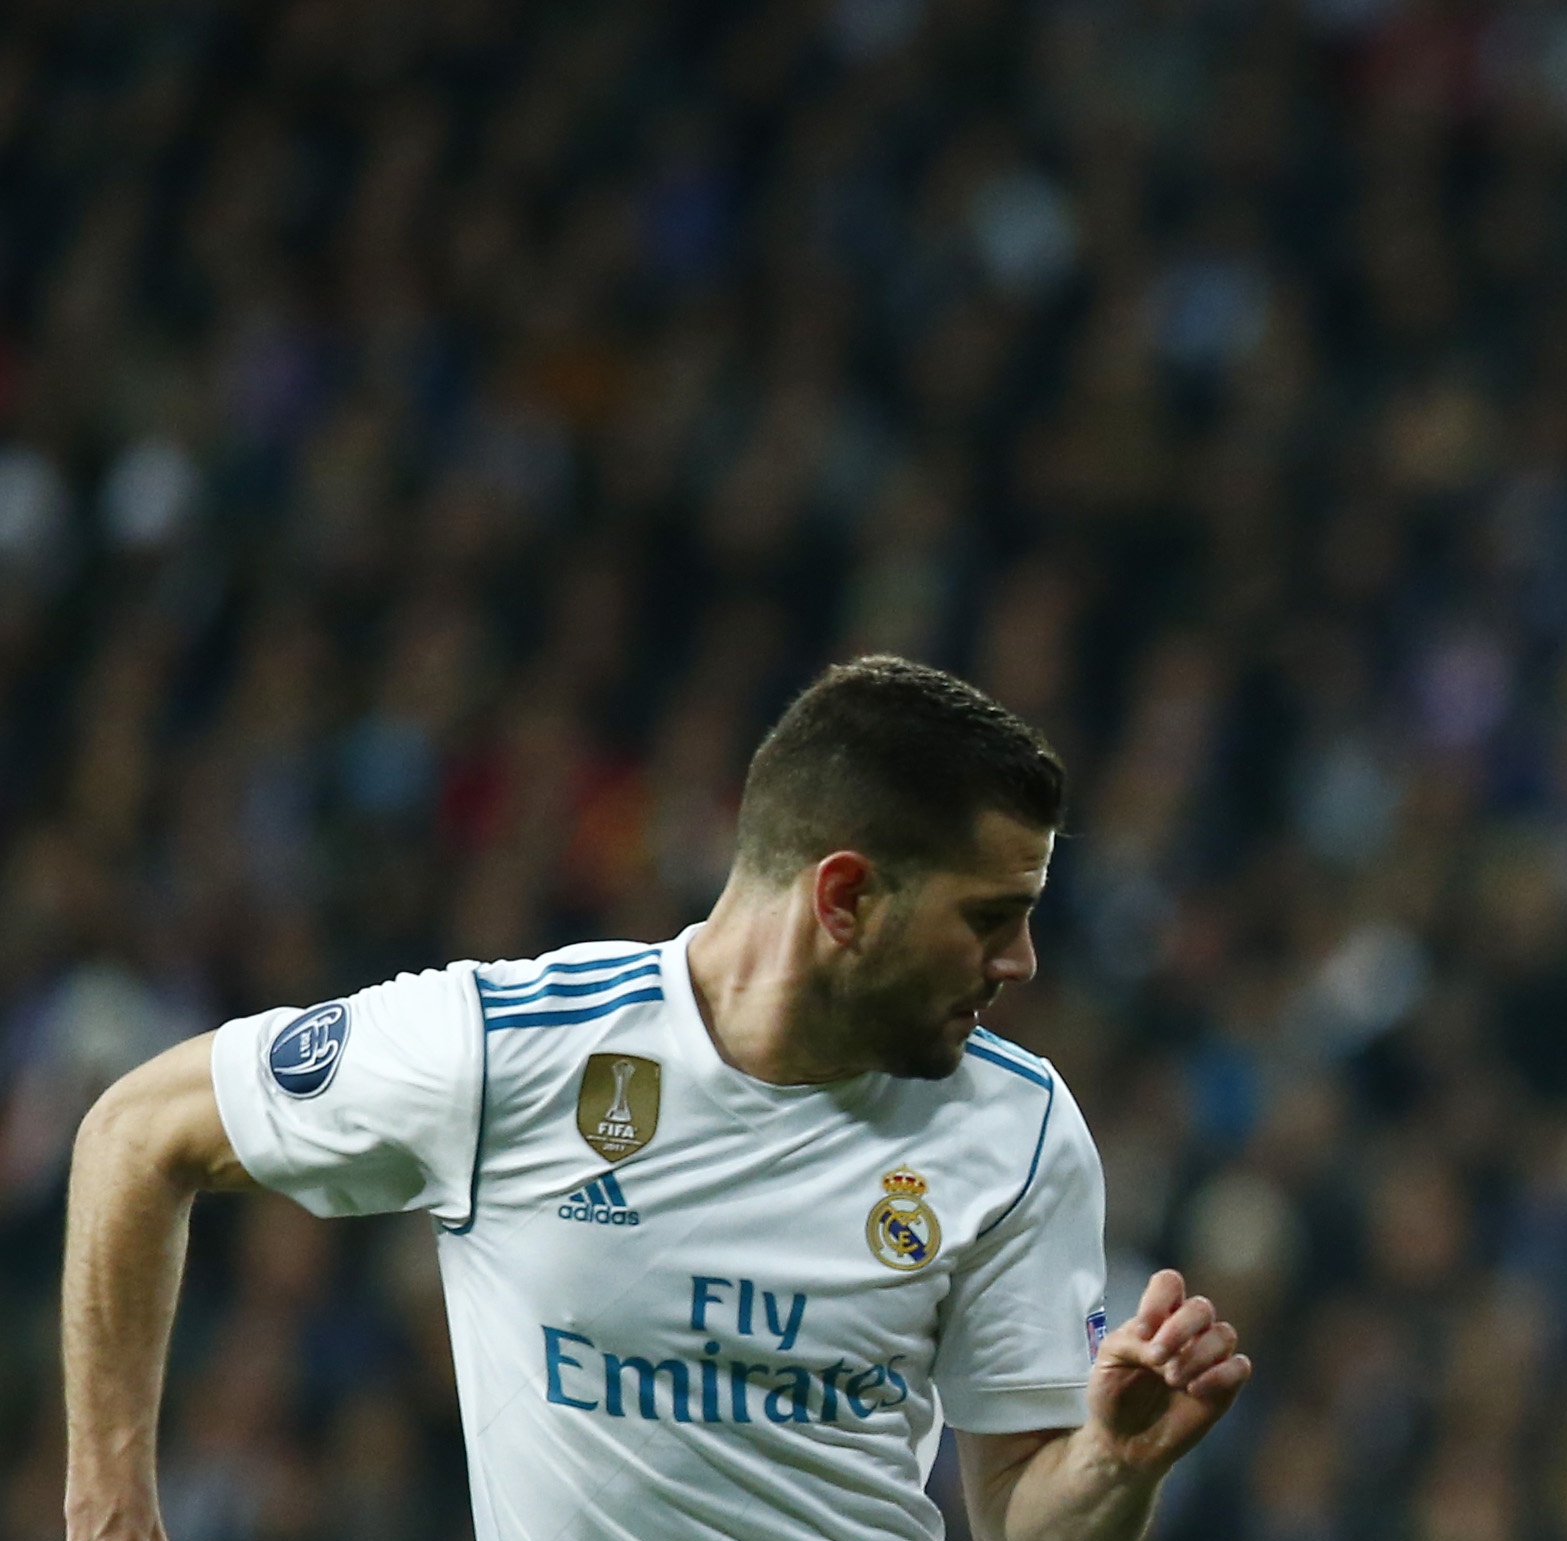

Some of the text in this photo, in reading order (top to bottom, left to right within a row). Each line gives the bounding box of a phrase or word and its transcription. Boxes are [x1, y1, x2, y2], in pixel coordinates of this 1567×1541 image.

[598, 1121, 635, 1139] FIFA
[558, 1202, 640, 1227] adidas
[691, 1275, 807, 1351] Fly
[541, 1324, 908, 1424] Emirates
